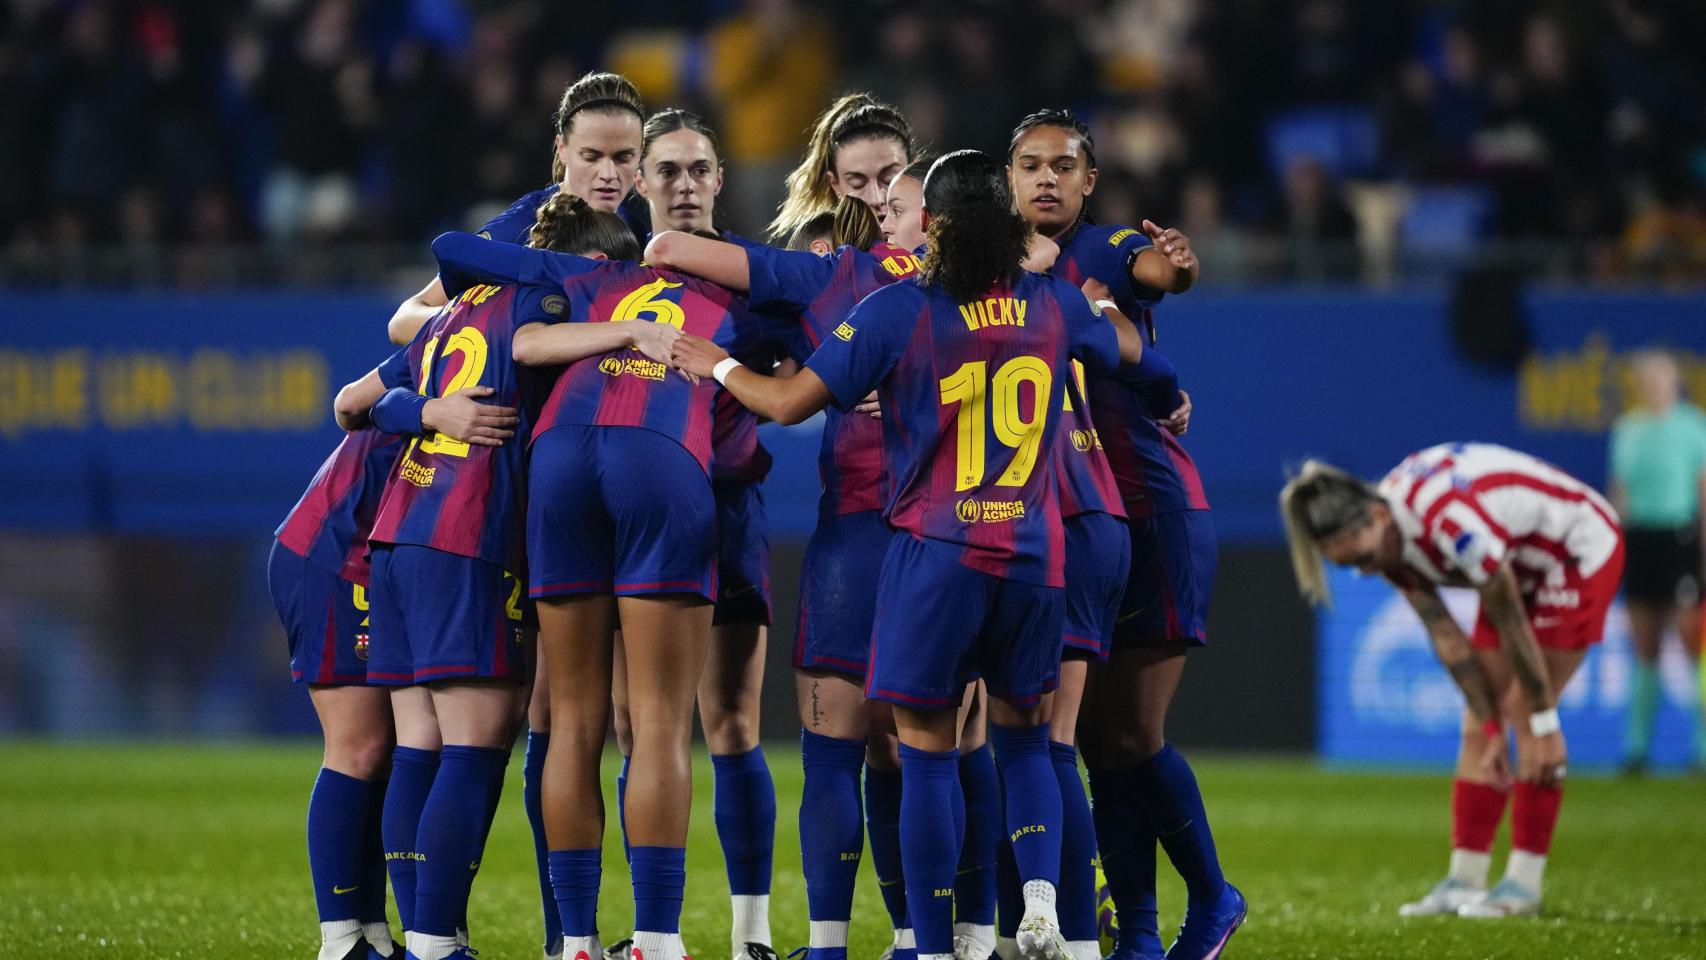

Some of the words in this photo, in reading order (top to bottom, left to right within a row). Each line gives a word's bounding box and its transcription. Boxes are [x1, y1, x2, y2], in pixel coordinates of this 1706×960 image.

[609, 277, 685, 350] 6
[959, 297, 1027, 332] VICKY
[624, 365, 665, 379] ACNUR
[627, 358, 667, 373] UNHCR
[940, 355, 1052, 492] 19
[982, 501, 1024, 511] UNHCR
[982, 506, 1025, 520] ACNUR
